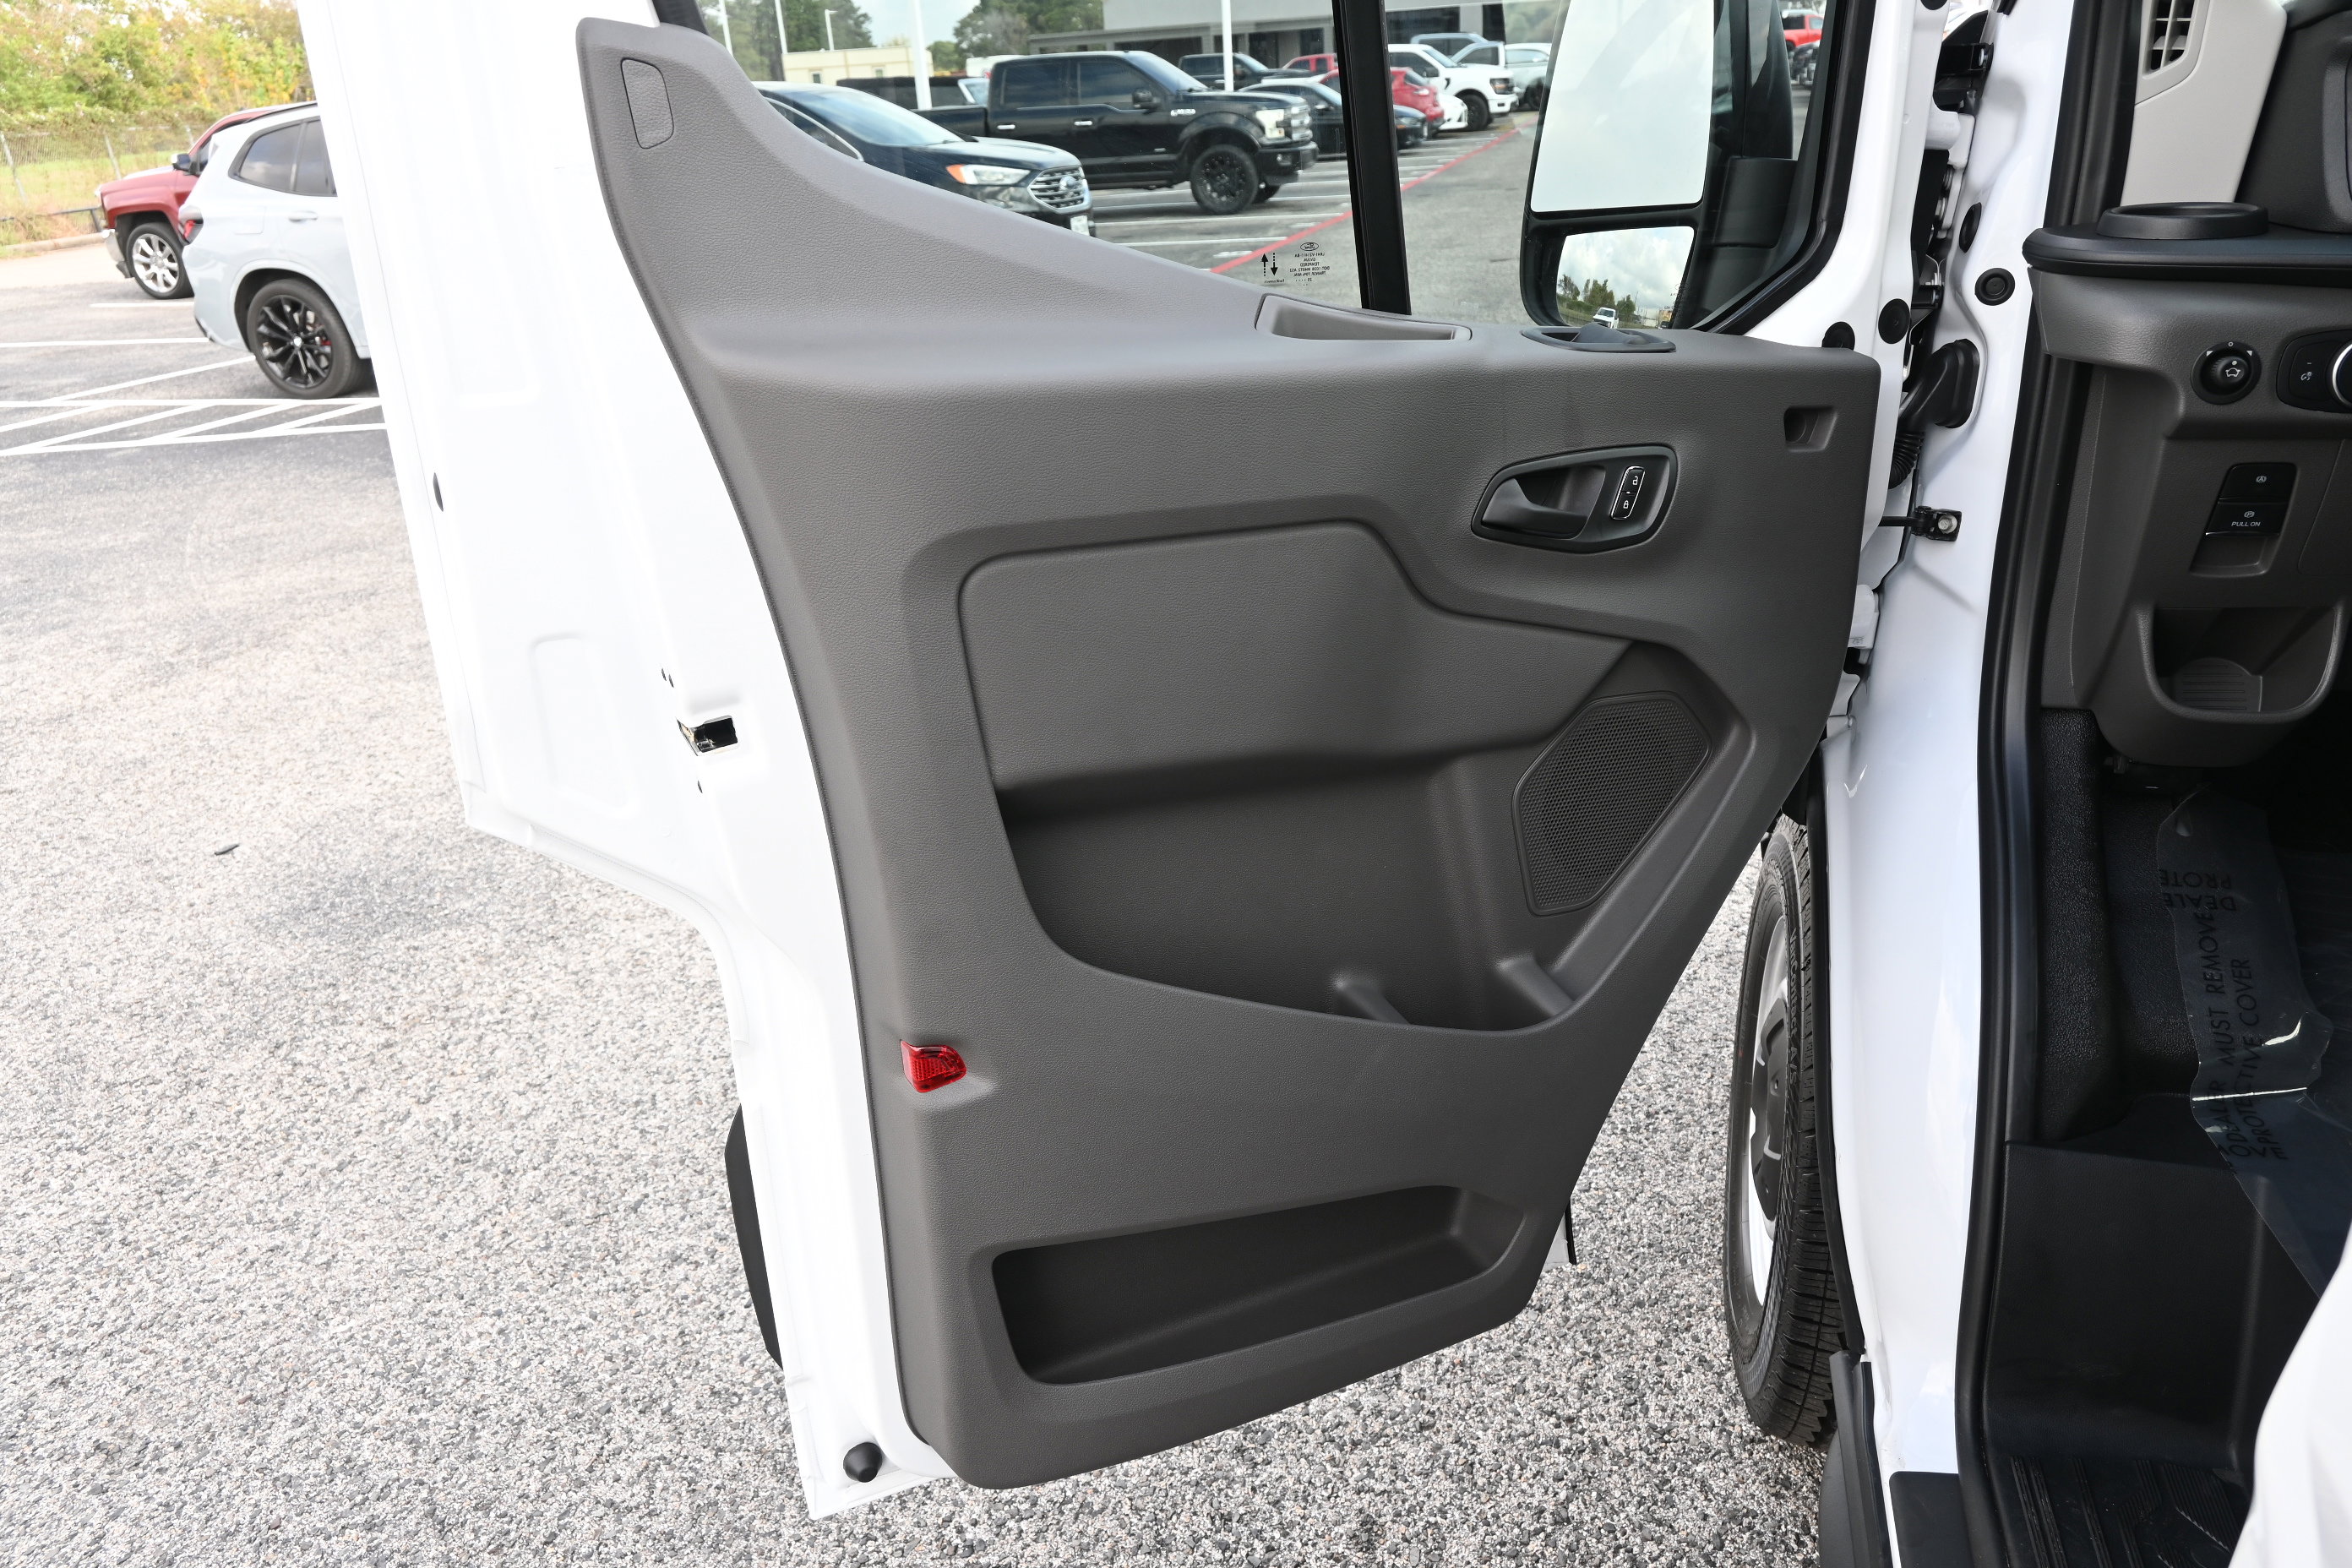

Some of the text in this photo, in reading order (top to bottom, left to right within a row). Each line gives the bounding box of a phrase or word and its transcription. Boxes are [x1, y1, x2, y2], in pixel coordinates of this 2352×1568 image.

[2194, 910, 2225, 995] REMOVE
[2208, 1006, 2235, 1067] MUST
[2231, 958, 2279, 1145] PROTECTIVE COVER
